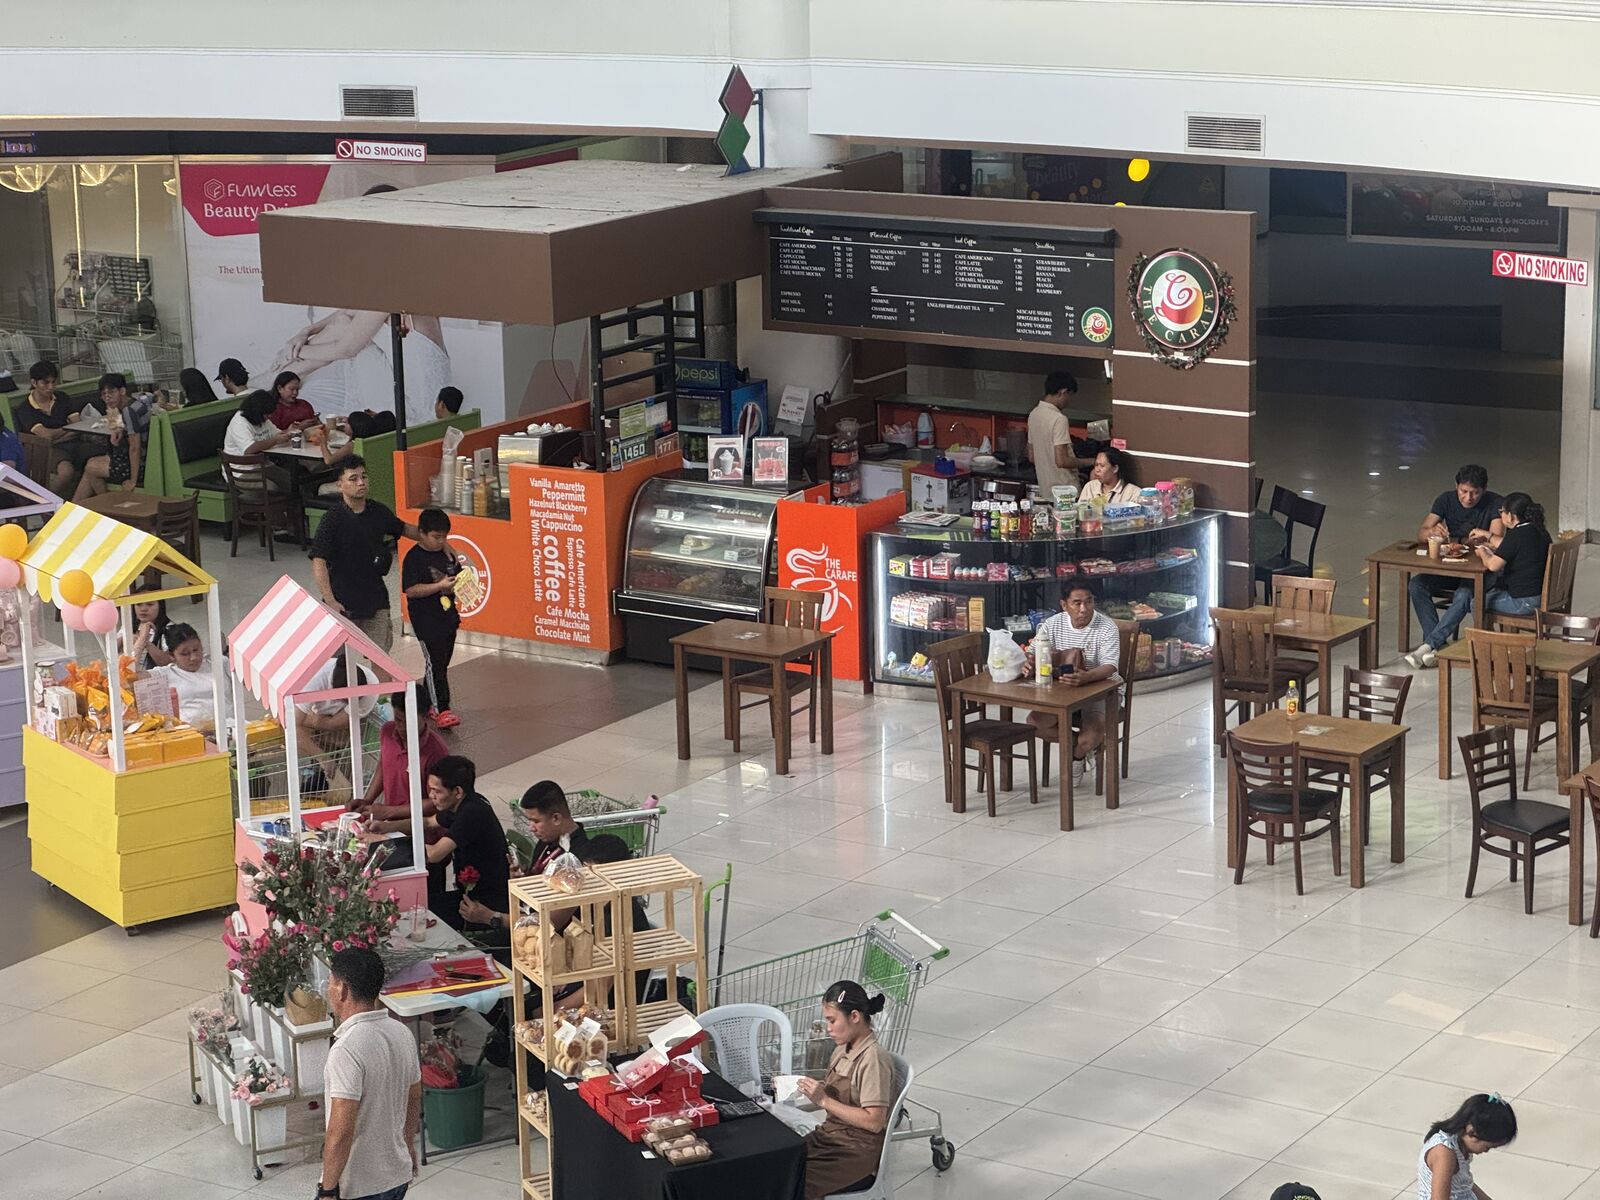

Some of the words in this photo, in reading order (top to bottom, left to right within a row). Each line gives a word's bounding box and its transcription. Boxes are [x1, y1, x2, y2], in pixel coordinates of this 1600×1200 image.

[356, 145, 371, 155] NO
[374, 146, 422, 158] SMOKING
[203, 203, 259, 222] Beauty
[1470, 216, 1503, 224] SUNDAYS
[1512, 218, 1550, 226] HOLIDAYS
[218, 265, 234, 275] The
[1518, 256, 1533, 276] NO
[1535, 258, 1585, 283] SMOKING
[1143, 285, 1157, 326] THE
[1164, 289, 1215, 344] CARAFE
[680, 367, 718, 380] pepsi
[623, 443, 646, 460] 1460
[529, 477, 552, 488] Vanilla
[554, 480, 586, 491] Amaretto
[542, 487, 586, 502] Peppermint
[528, 498, 555, 508] Hazelnut
[556, 500, 588, 515] Blackberry
[530, 509, 563, 519] Macadamia
[563, 512, 576, 521] Nut
[530, 519, 541, 546] White
[541, 518, 583, 533] Cappuccino
[565, 537, 575, 570] Espresso
[575, 538, 586, 559] Cafe
[532, 548, 542, 577] Choco
[542, 534, 566, 602] coffee
[825, 557, 841, 569] THE
[568, 571, 576, 588] Cafe
[825, 568, 857, 582] CARAFE
[534, 579, 543, 602] Latte
[577, 560, 587, 609] Americano
[568, 589, 576, 608] Latte
[546, 604, 563, 617] Cafe
[564, 608, 590, 621] Mocha
[534, 614, 558, 626] Caramel
[559, 618, 590, 631] Macchiato
[535, 625, 572, 640] Chocolate
[572, 631, 591, 643] Mint
